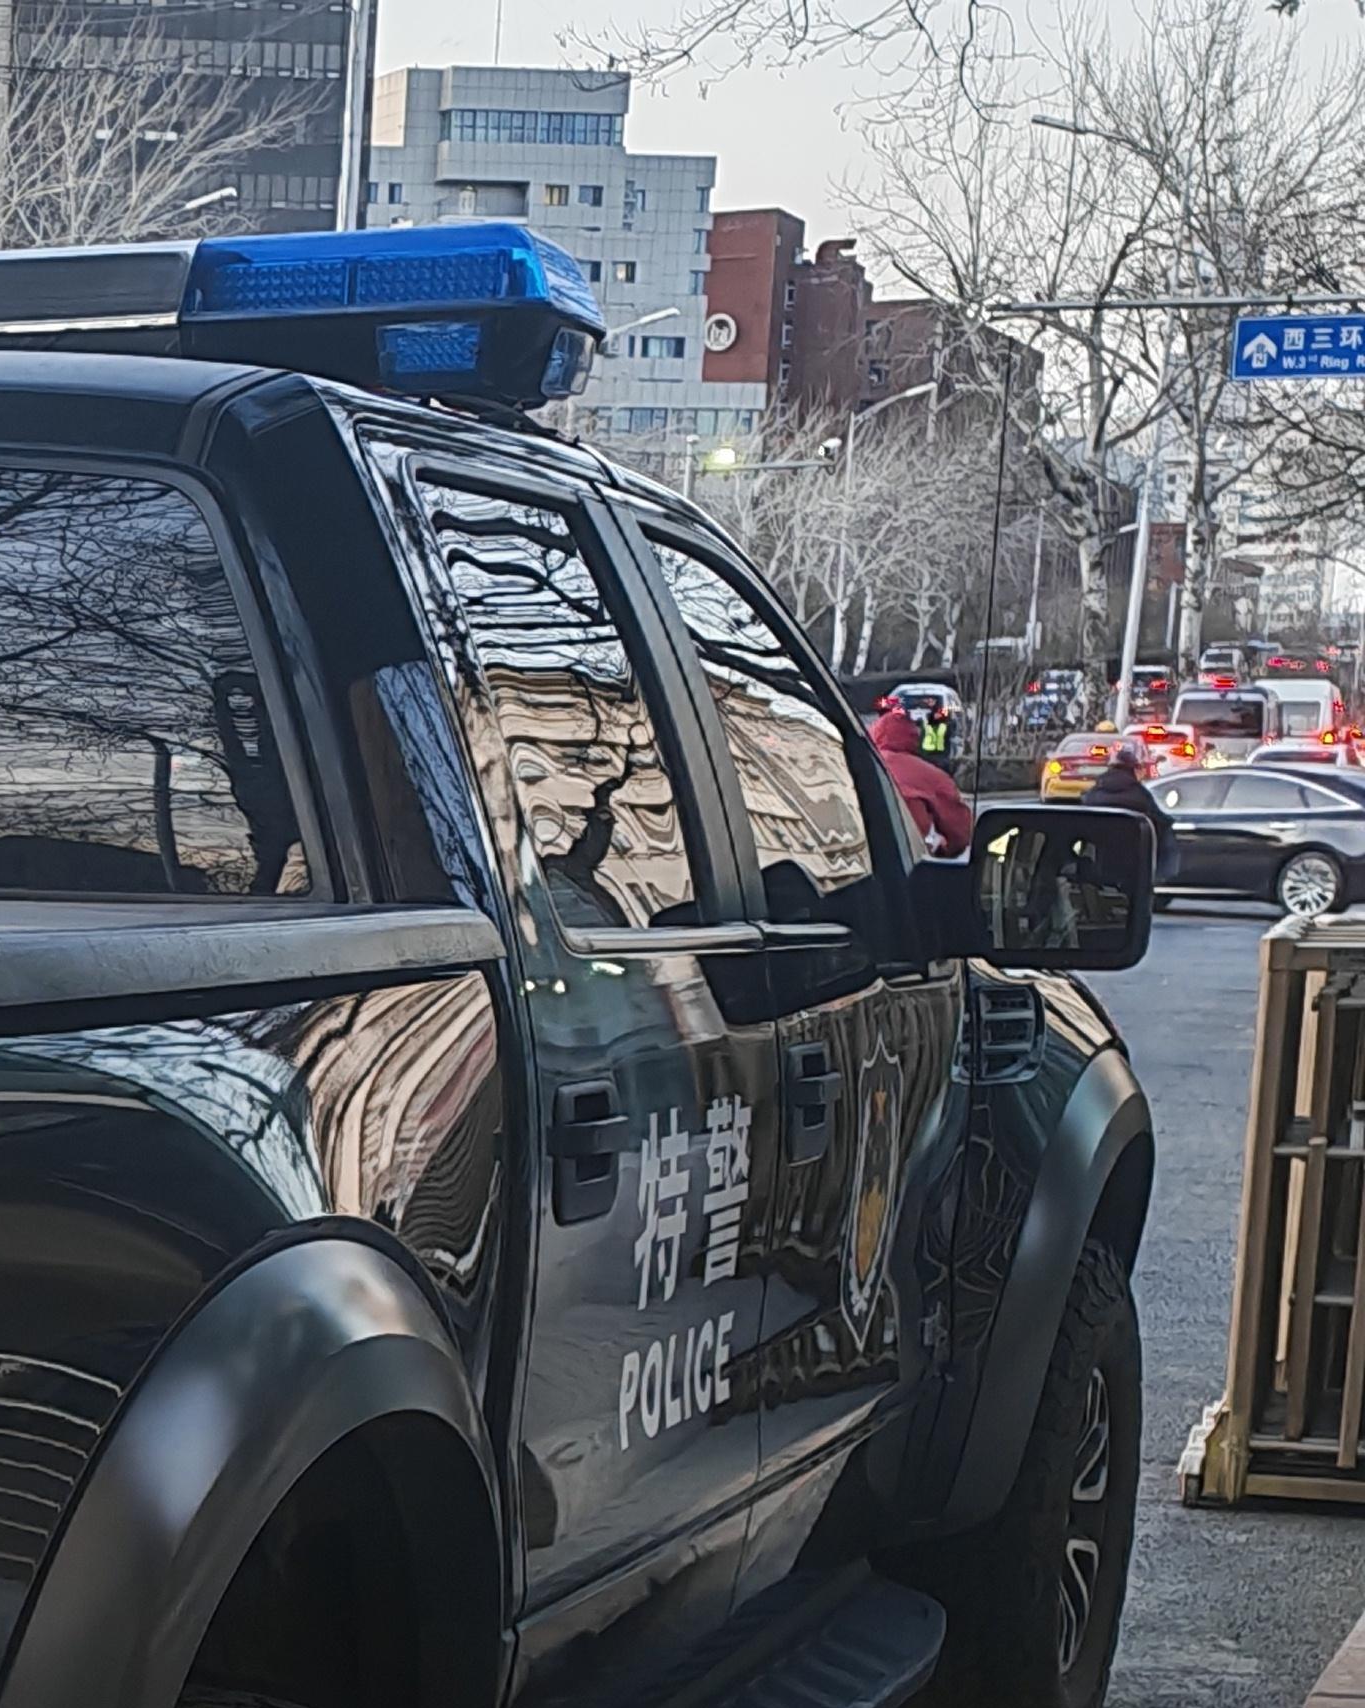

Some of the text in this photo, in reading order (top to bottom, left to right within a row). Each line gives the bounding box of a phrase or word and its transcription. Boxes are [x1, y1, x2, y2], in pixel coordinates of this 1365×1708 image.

[1282, 326, 1365, 350] 西三环
[1319, 354, 1350, 371] Ring
[634, 1093, 753, 1311] 特警
[618, 1310, 735, 1451] POLICE
